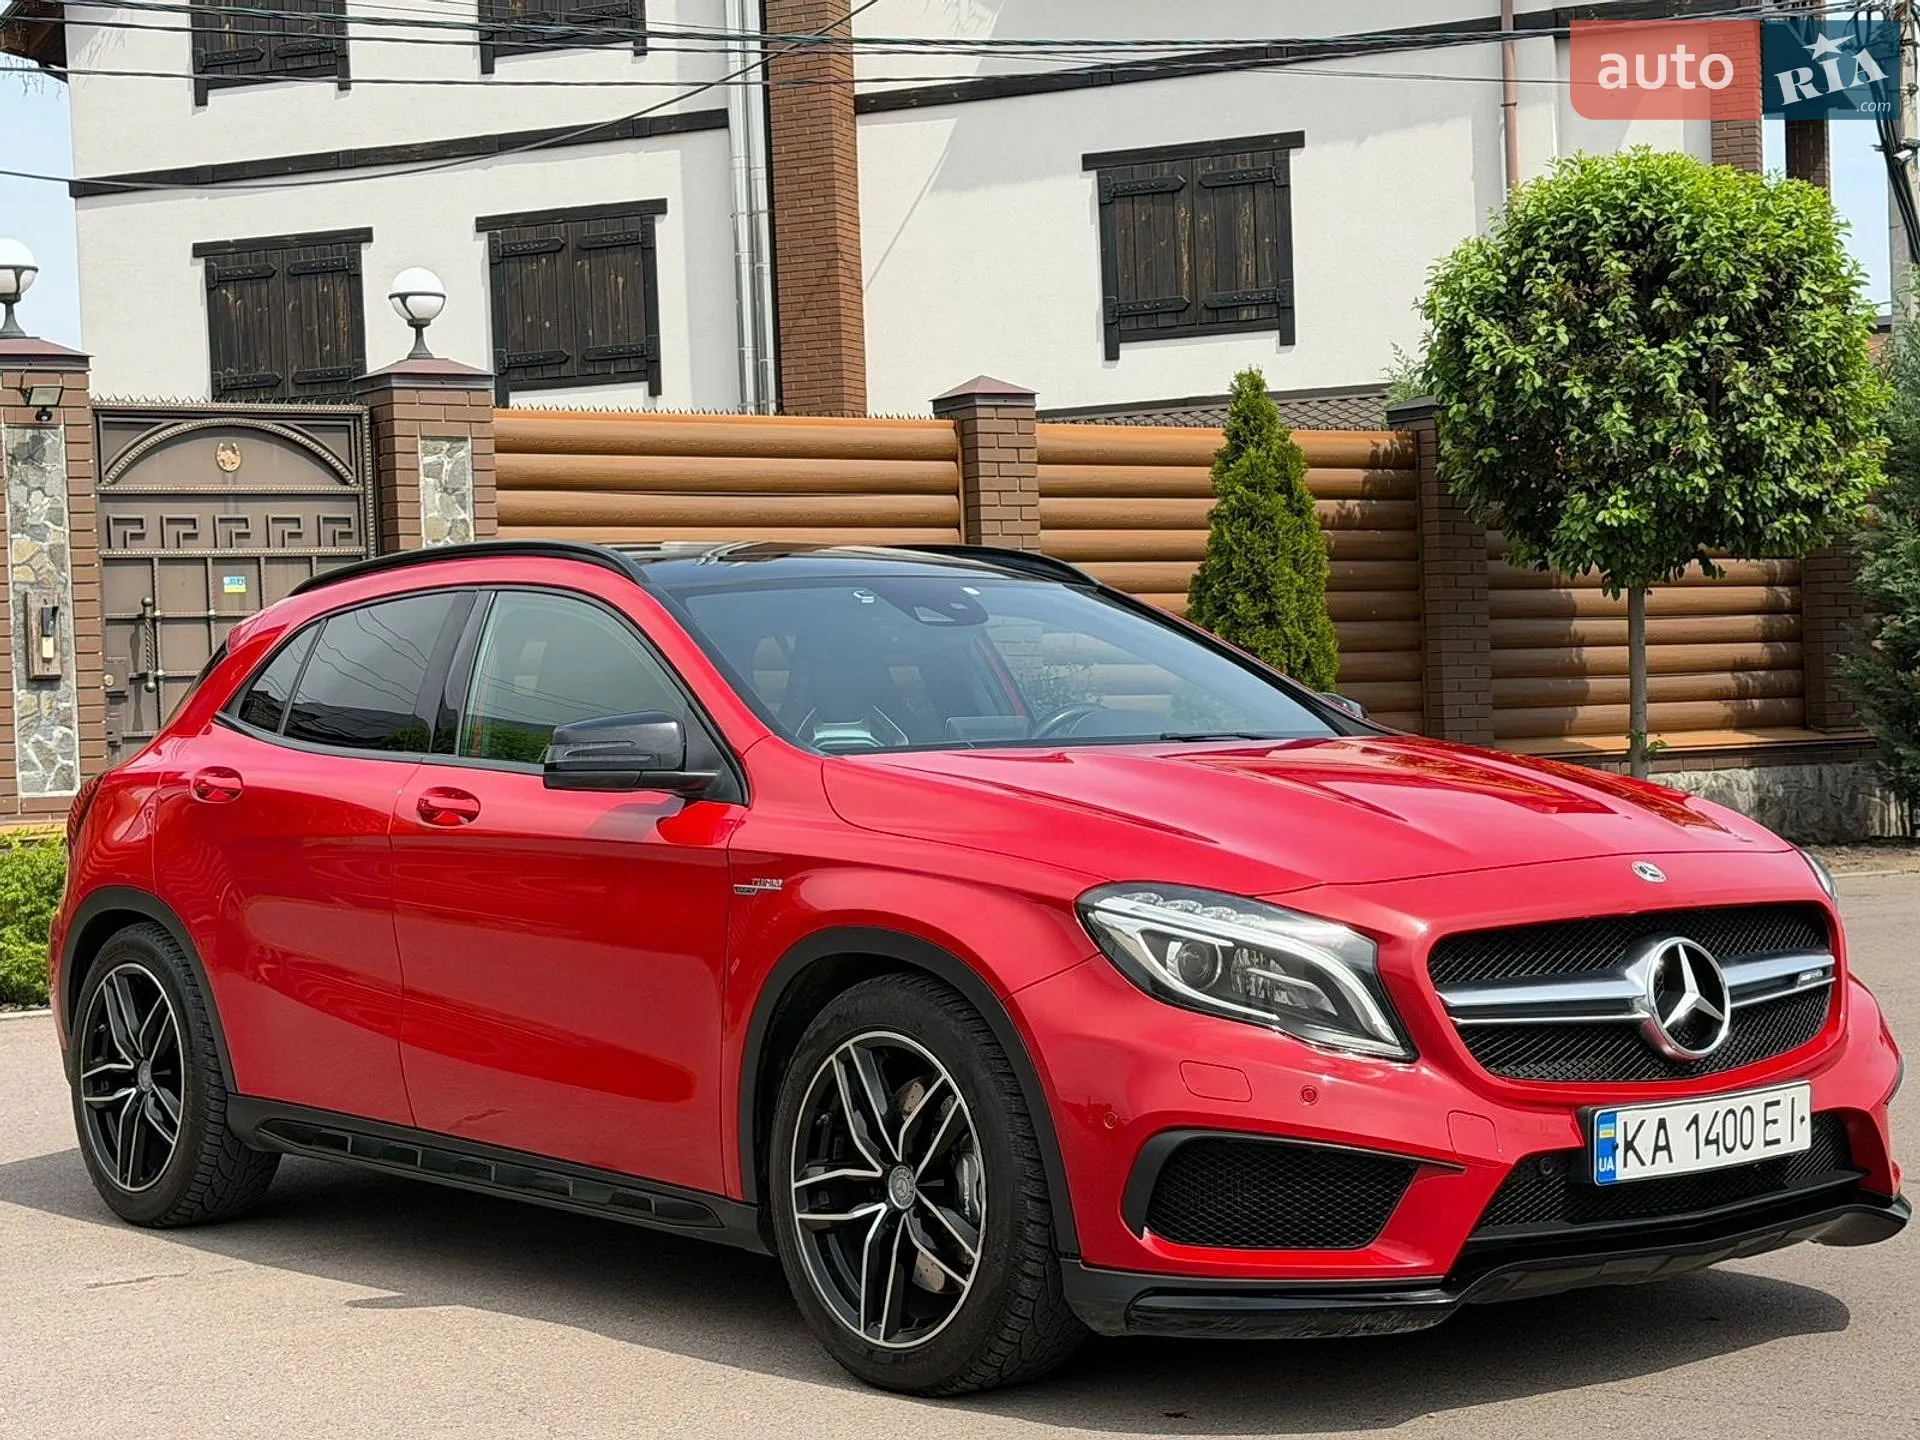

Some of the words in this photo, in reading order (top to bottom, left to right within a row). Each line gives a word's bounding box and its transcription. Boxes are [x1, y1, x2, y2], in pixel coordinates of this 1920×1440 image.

[1623, 1117, 1673, 1168] KA
[1685, 1105, 1754, 1160] 1400
[1763, 1097, 1796, 1147] EI
[1599, 1155, 1614, 1172] UA
